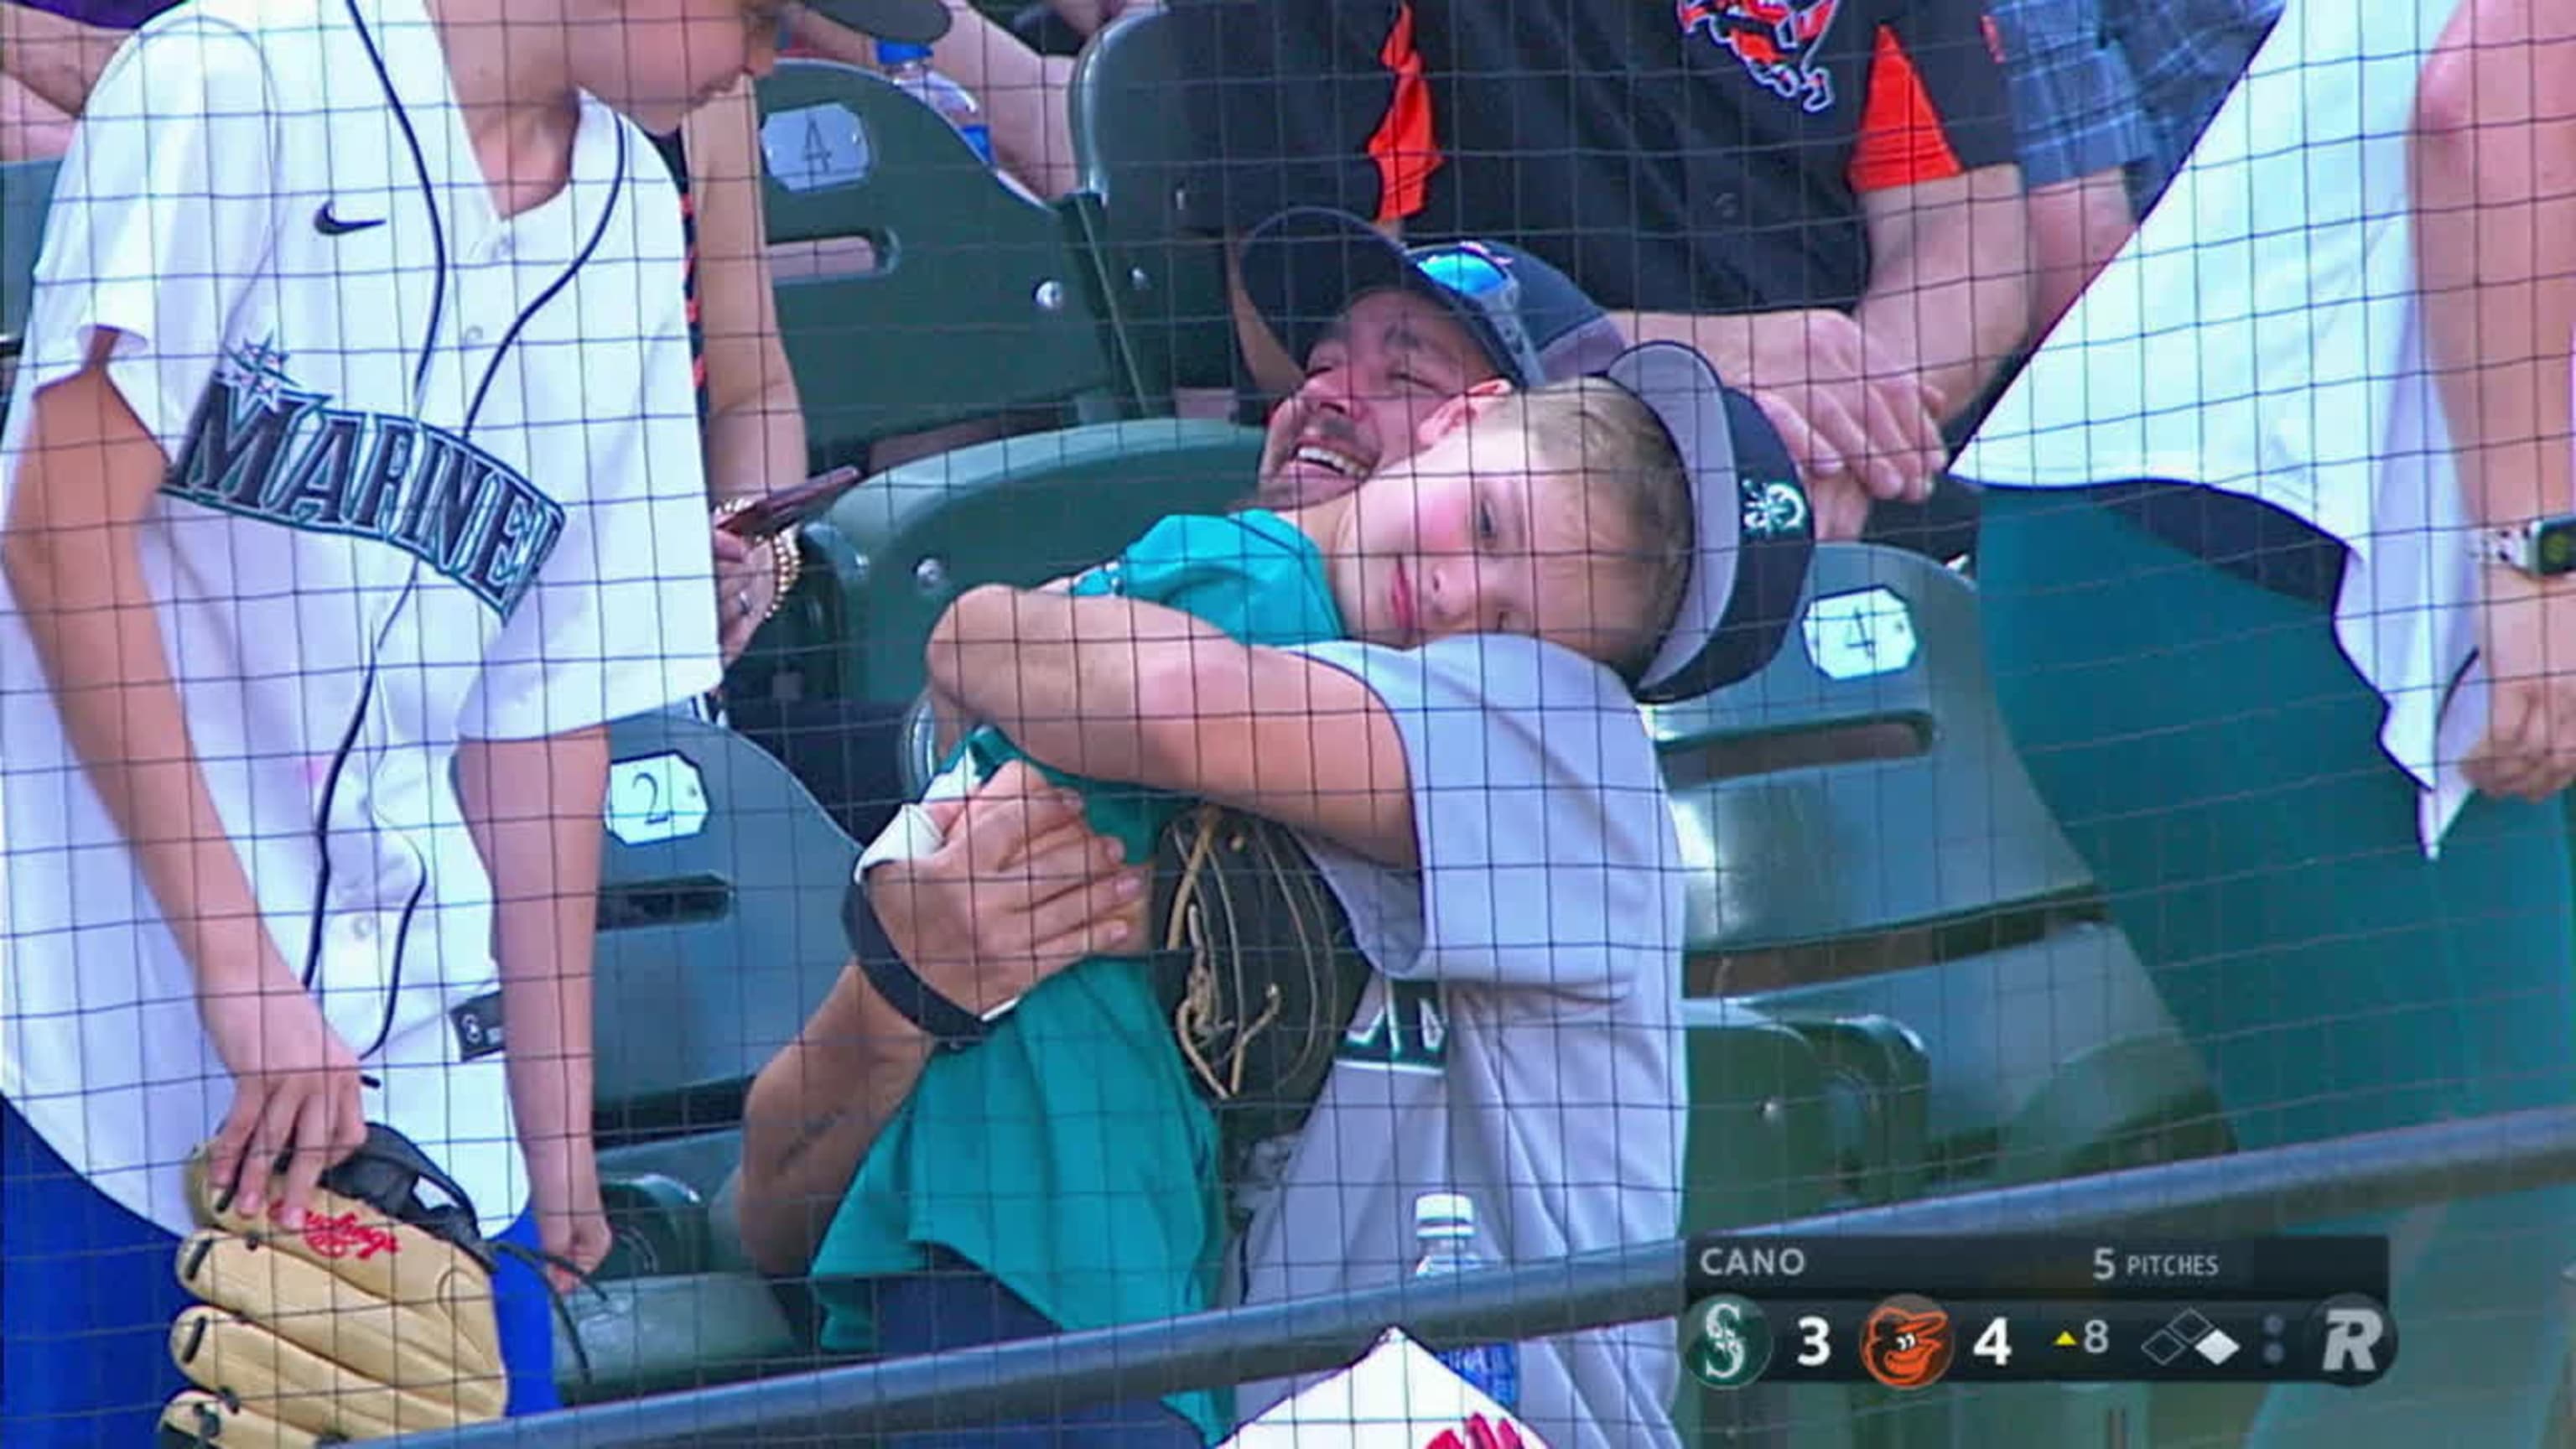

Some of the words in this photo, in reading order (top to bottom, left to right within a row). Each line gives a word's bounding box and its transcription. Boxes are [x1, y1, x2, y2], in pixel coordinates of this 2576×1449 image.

[803, 120, 833, 173] 4
[1846, 607, 1875, 657] 4
[631, 772, 670, 825] 2
